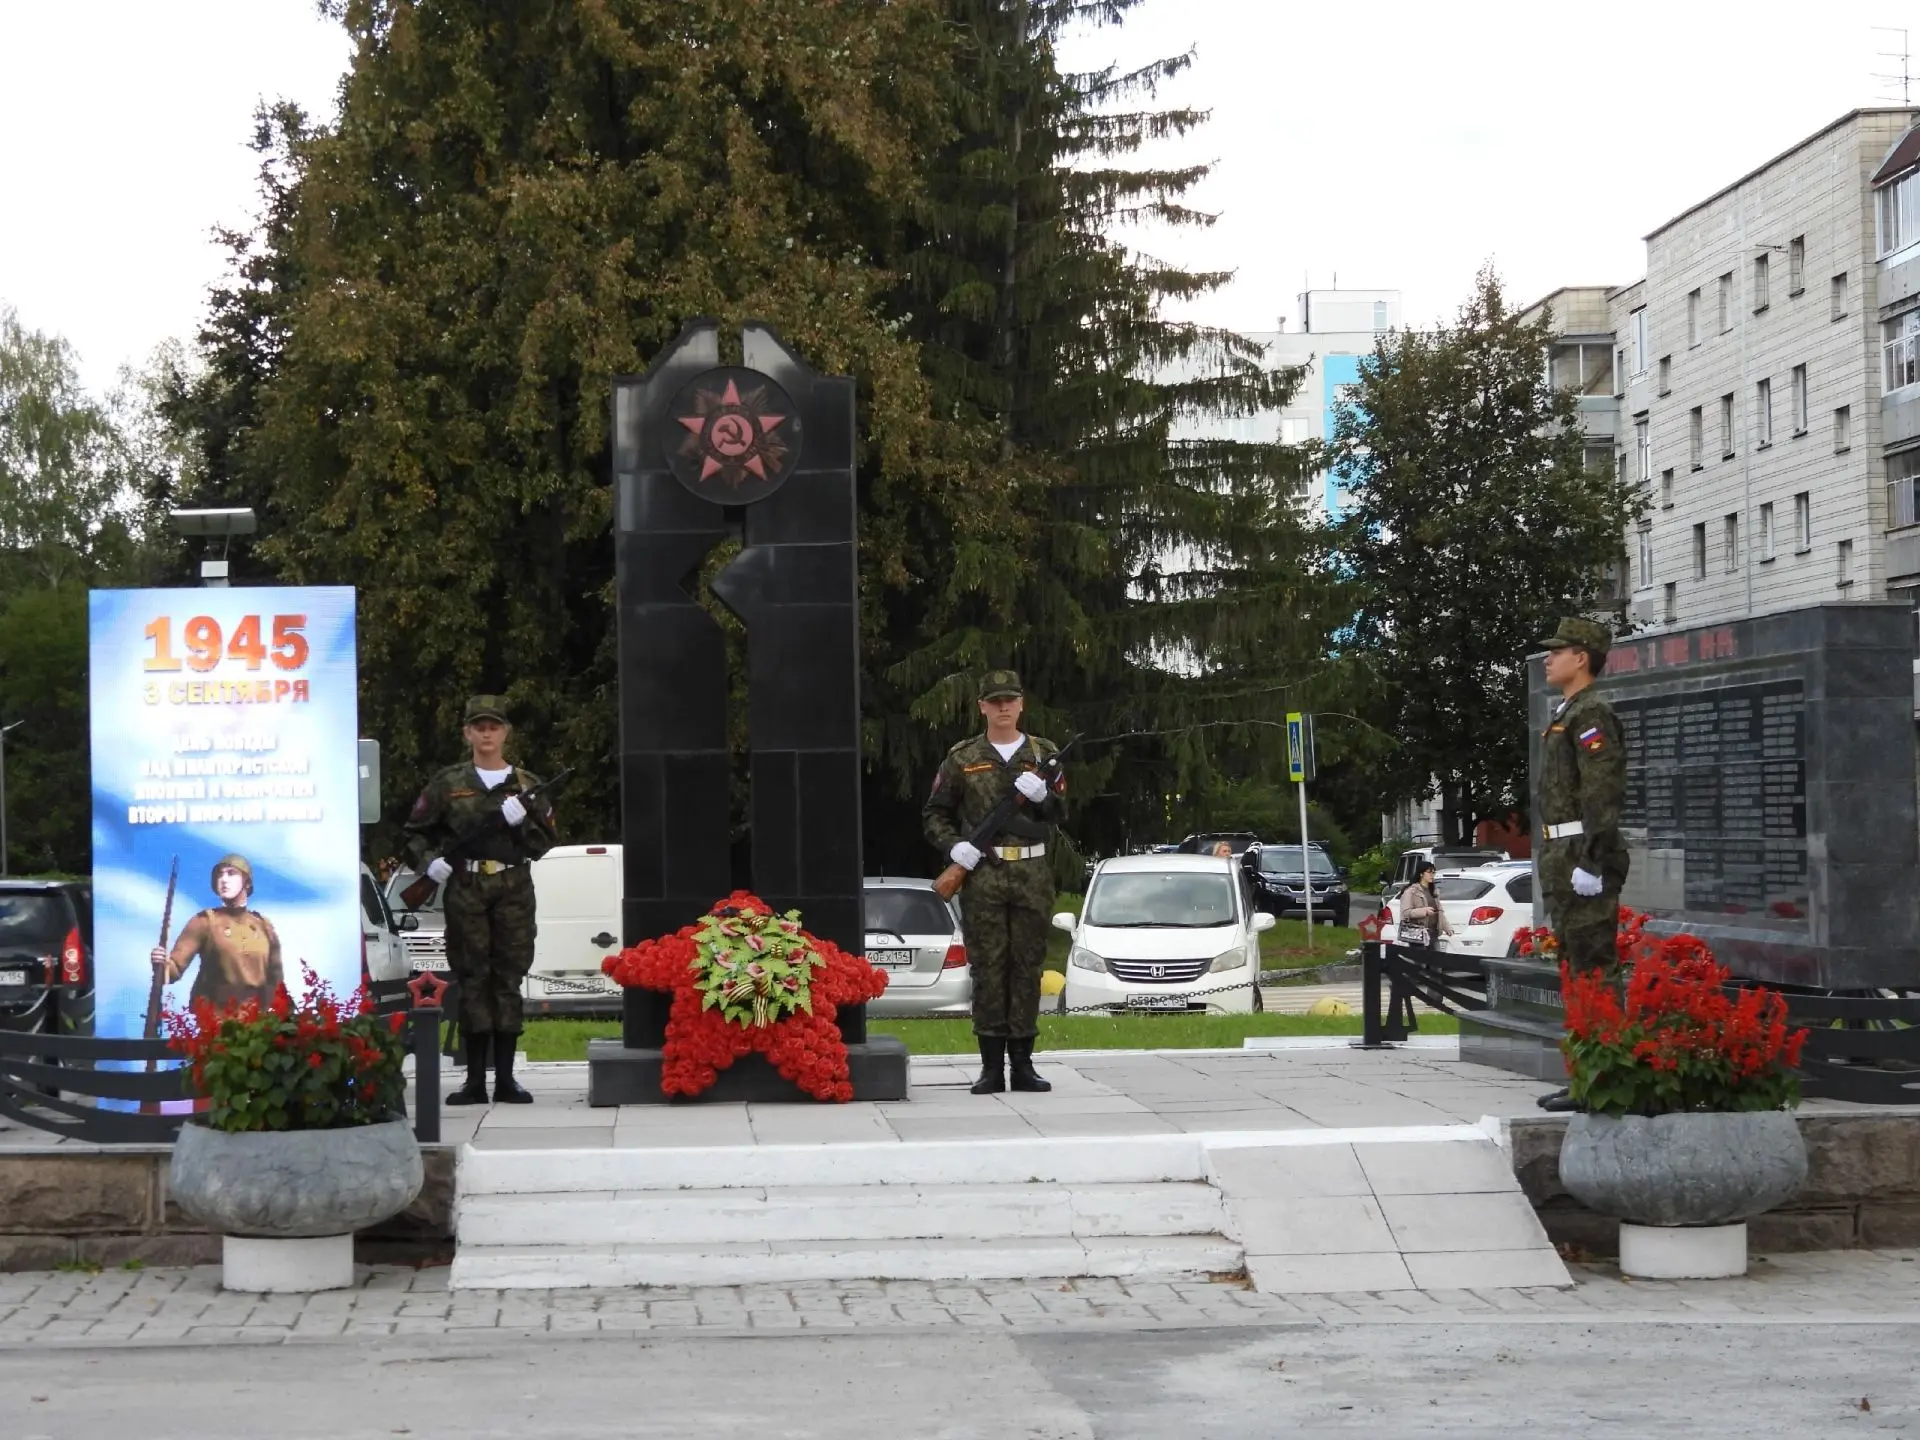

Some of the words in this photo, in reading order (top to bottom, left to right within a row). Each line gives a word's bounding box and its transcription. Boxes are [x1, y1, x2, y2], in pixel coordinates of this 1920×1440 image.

[143, 614, 310, 673] 1945
[143, 681, 161, 706] 3
[168, 679, 310, 705] СЕНТЯБРЯ
[128, 801, 186, 824] ВТОРОЙ
[893, 951, 909, 960] 154
